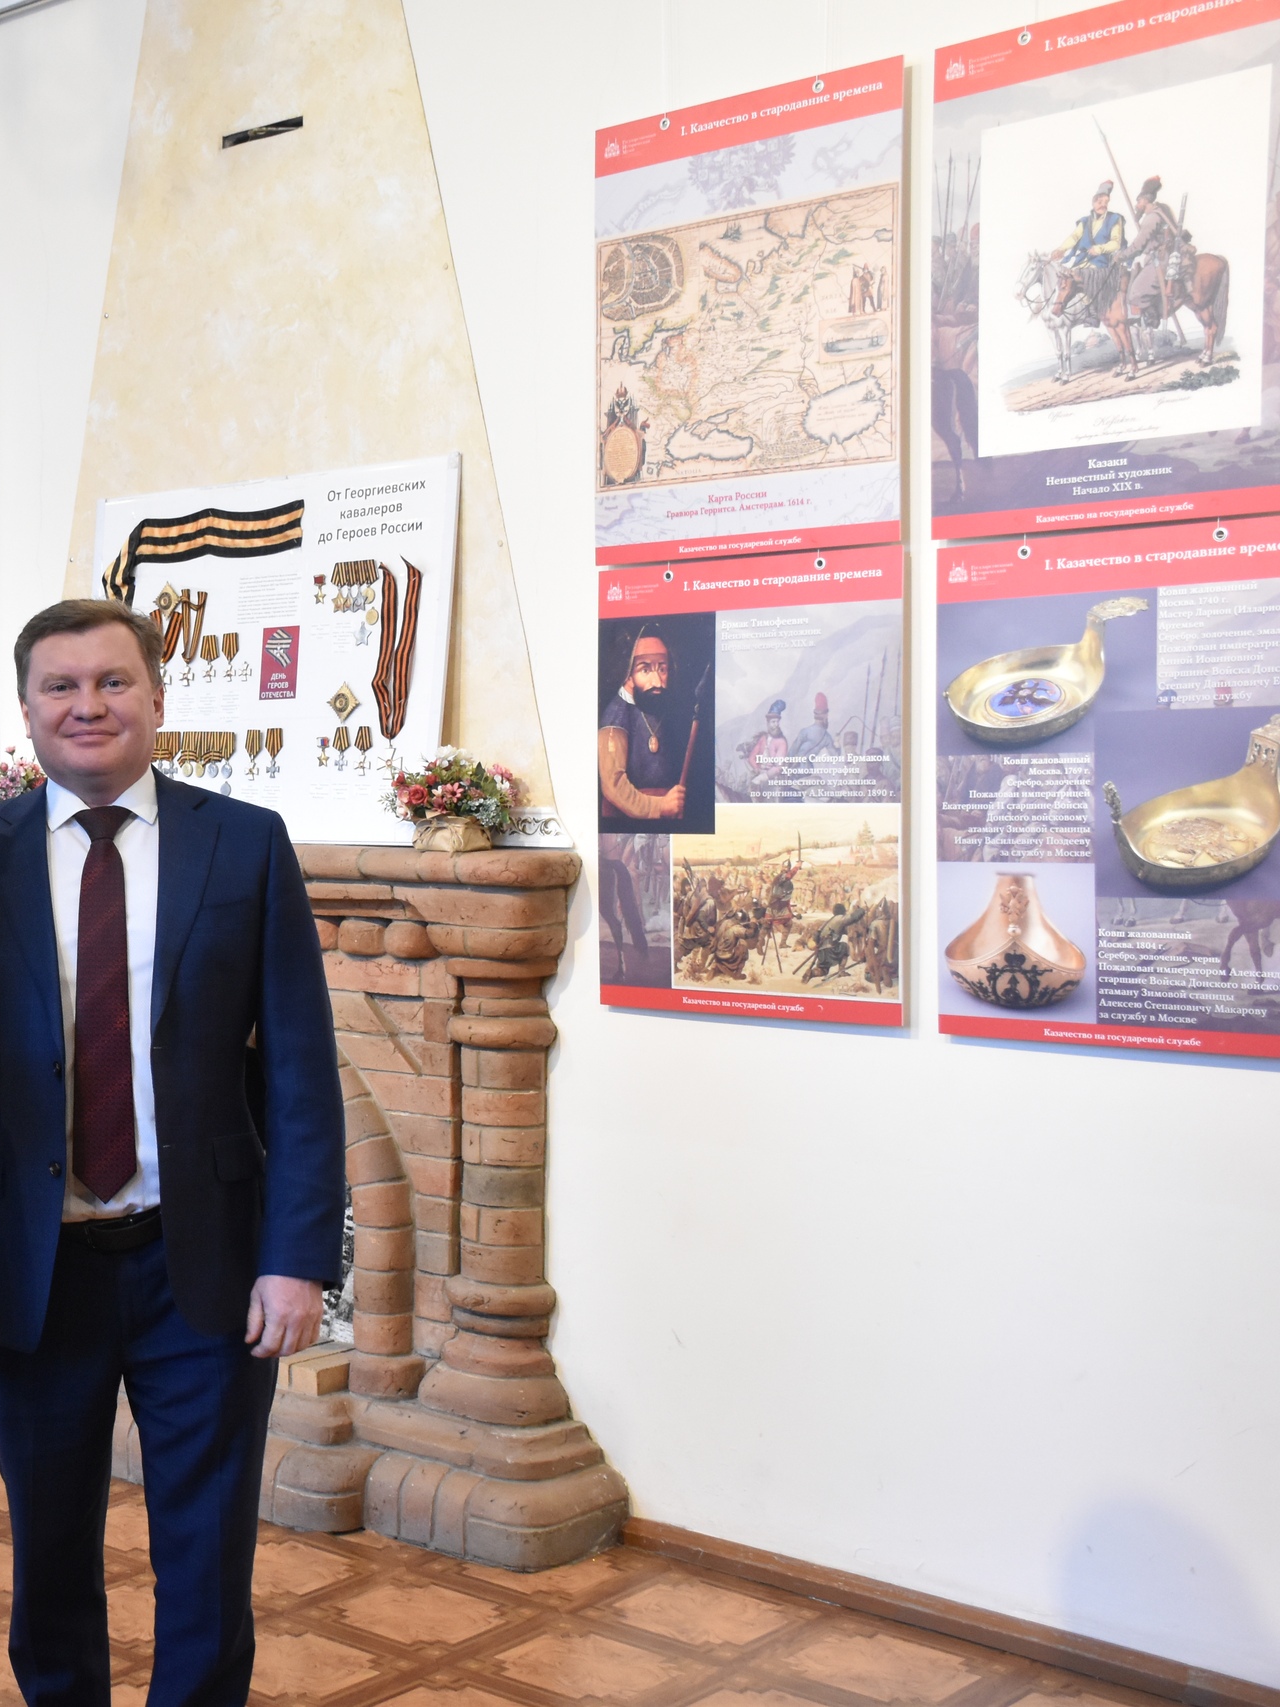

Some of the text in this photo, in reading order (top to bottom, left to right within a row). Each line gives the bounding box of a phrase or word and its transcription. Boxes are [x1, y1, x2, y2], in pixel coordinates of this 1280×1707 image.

[1057, 22, 1134, 48] Казачество
[1137, 18, 1146, 28] в
[690, 112, 749, 134] Казачество
[751, 110, 758, 120] в
[760, 94, 830, 118] стародавние
[832, 81, 883, 101] времена
[1088, 457, 1127, 469] Казаки
[1046, 466, 1172, 486] Неизвестный художник
[327, 480, 426, 501] От Георгиевских
[1072, 484, 1109, 496] Начало
[708, 490, 767, 504] Карта России
[340, 503, 403, 519] кавалеров
[666, 508, 698, 518] Гравюра
[788, 498, 804, 507] 1614
[1036, 510, 1085, 523] Казачество
[1099, 504, 1157, 519] государевой
[1158, 501, 1194, 516] службе
[318, 521, 423, 545] до Героев России
[679, 543, 717, 554] Казачество
[728, 538, 772, 551] государевой
[774, 536, 802, 547] службе
[1056, 552, 1131, 569] Казачество
[1134, 554, 1142, 563] в
[1146, 543, 1234, 566] стародавние
[693, 576, 751, 591] Казачество
[752, 578, 760, 586] в
[762, 570, 831, 588] стародавние
[833, 567, 882, 582] времена
[1159, 582, 1257, 596] Ковш жалованный
[1198, 597, 1219, 605] 1740
[1159, 610, 1193, 619] Мастер
[722, 617, 809, 631] Ермак Тимофеевич
[1159, 621, 1204, 631] Артемьев
[779, 628, 821, 638] художник
[1159, 644, 1216, 653] Пожалован
[1158, 656, 1192, 666] Анной
[271, 673, 286, 681] ДЕНЬ
[1212, 666, 1250, 676] Войска
[268, 681, 288, 689] ГЕРОЕВ
[1158, 678, 1270, 691] Степану Даниловичу
[261, 691, 294, 699] ОТЕЧЕСТВА
[1170, 694, 1210, 703] верную
[1213, 691, 1252, 703] службу
[756, 754, 890, 764] Покорение Сибири Ермаком
[1003, 755, 1091, 765] Ковш жалованный
[781, 765, 860, 776] Хромолитография
[768, 778, 876, 786] неизвестного художника
[868, 789, 887, 797] 1890
[969, 789, 1090, 799] Пожалован императрицей
[942, 802, 994, 811] Екатериной
[1007, 803, 1052, 811] старшине
[1054, 801, 1088, 809] Войска
[986, 814, 1088, 823] Донского войсковому
[968, 825, 1091, 834] атаману Зимовой станицы
[954, 837, 1091, 846] Ивану Васильевичу Поздееву
[1011, 849, 1046, 858] службу
[1098, 929, 1192, 940] Ковш жалованный
[1098, 940, 1133, 949] Москва.
[1136, 942, 1156, 950] 1804
[1192, 956, 1220, 964] чернь
[1099, 963, 1154, 972] Пожалован
[1156, 966, 1226, 977] императором
[1099, 976, 1147, 985] старшине
[1150, 977, 1186, 986] Войска
[1188, 979, 1238, 989] Донского
[1099, 988, 1234, 1002] атаману Зимовой станицы
[682, 996, 721, 1007] Казачество
[732, 1000, 776, 1012] государевой
[777, 1002, 804, 1014] службе
[1099, 999, 1267, 1018] Алексею Степановичу Макарову
[1111, 1011, 1147, 1023] службу
[1158, 1014, 1197, 1024] Москве
[1044, 1028, 1201, 1048] Казачество на государевой службе
